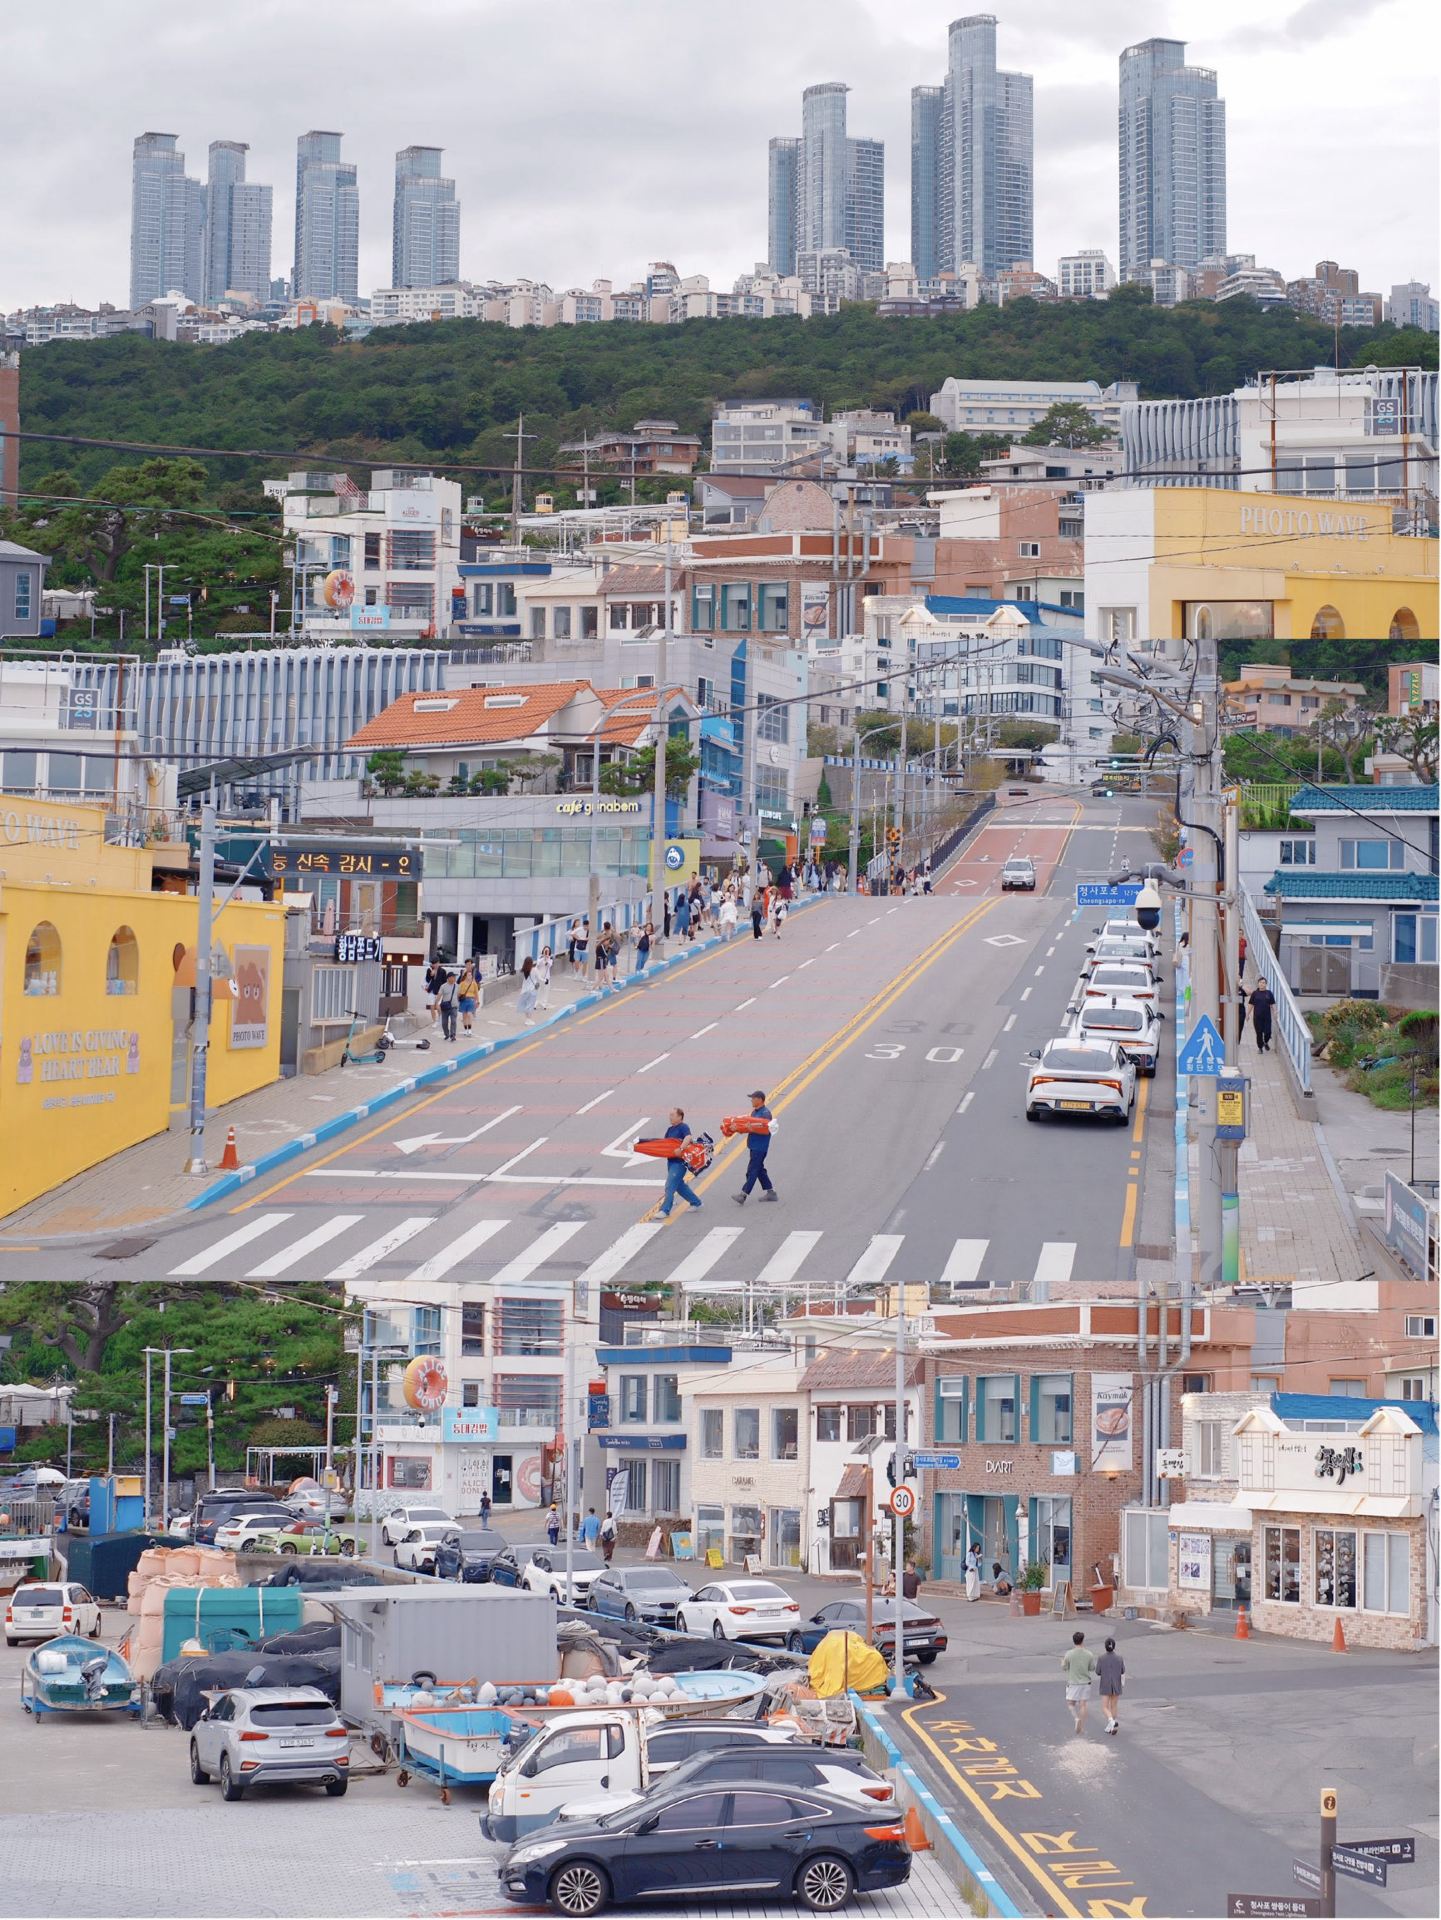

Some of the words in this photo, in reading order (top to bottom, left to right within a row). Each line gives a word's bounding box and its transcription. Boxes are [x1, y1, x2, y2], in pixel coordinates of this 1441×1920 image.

[1377, 403, 1394, 413] GS
[1240, 506, 1313, 536] PHOTO
[1317, 511, 1369, 541] WAVE
[1411, 672, 1421, 704] PIZZA
[74, 693, 93, 705] GS
[26, 813, 80, 850] WAVE
[297, 853, 330, 872] 신속
[339, 855, 372, 873] 감시
[1080, 886, 1119, 897] 청사포로
[34, 1032, 68, 1055] LOVE
[71, 1031, 82, 1053] IS
[85, 1029, 129, 1051] GIVING
[865, 1044, 965, 1062] 30
[41, 1058, 84, 1082] HEART
[896, 1494, 909, 1508] 30
[1250, 1900, 1270, 1910] 청사포
